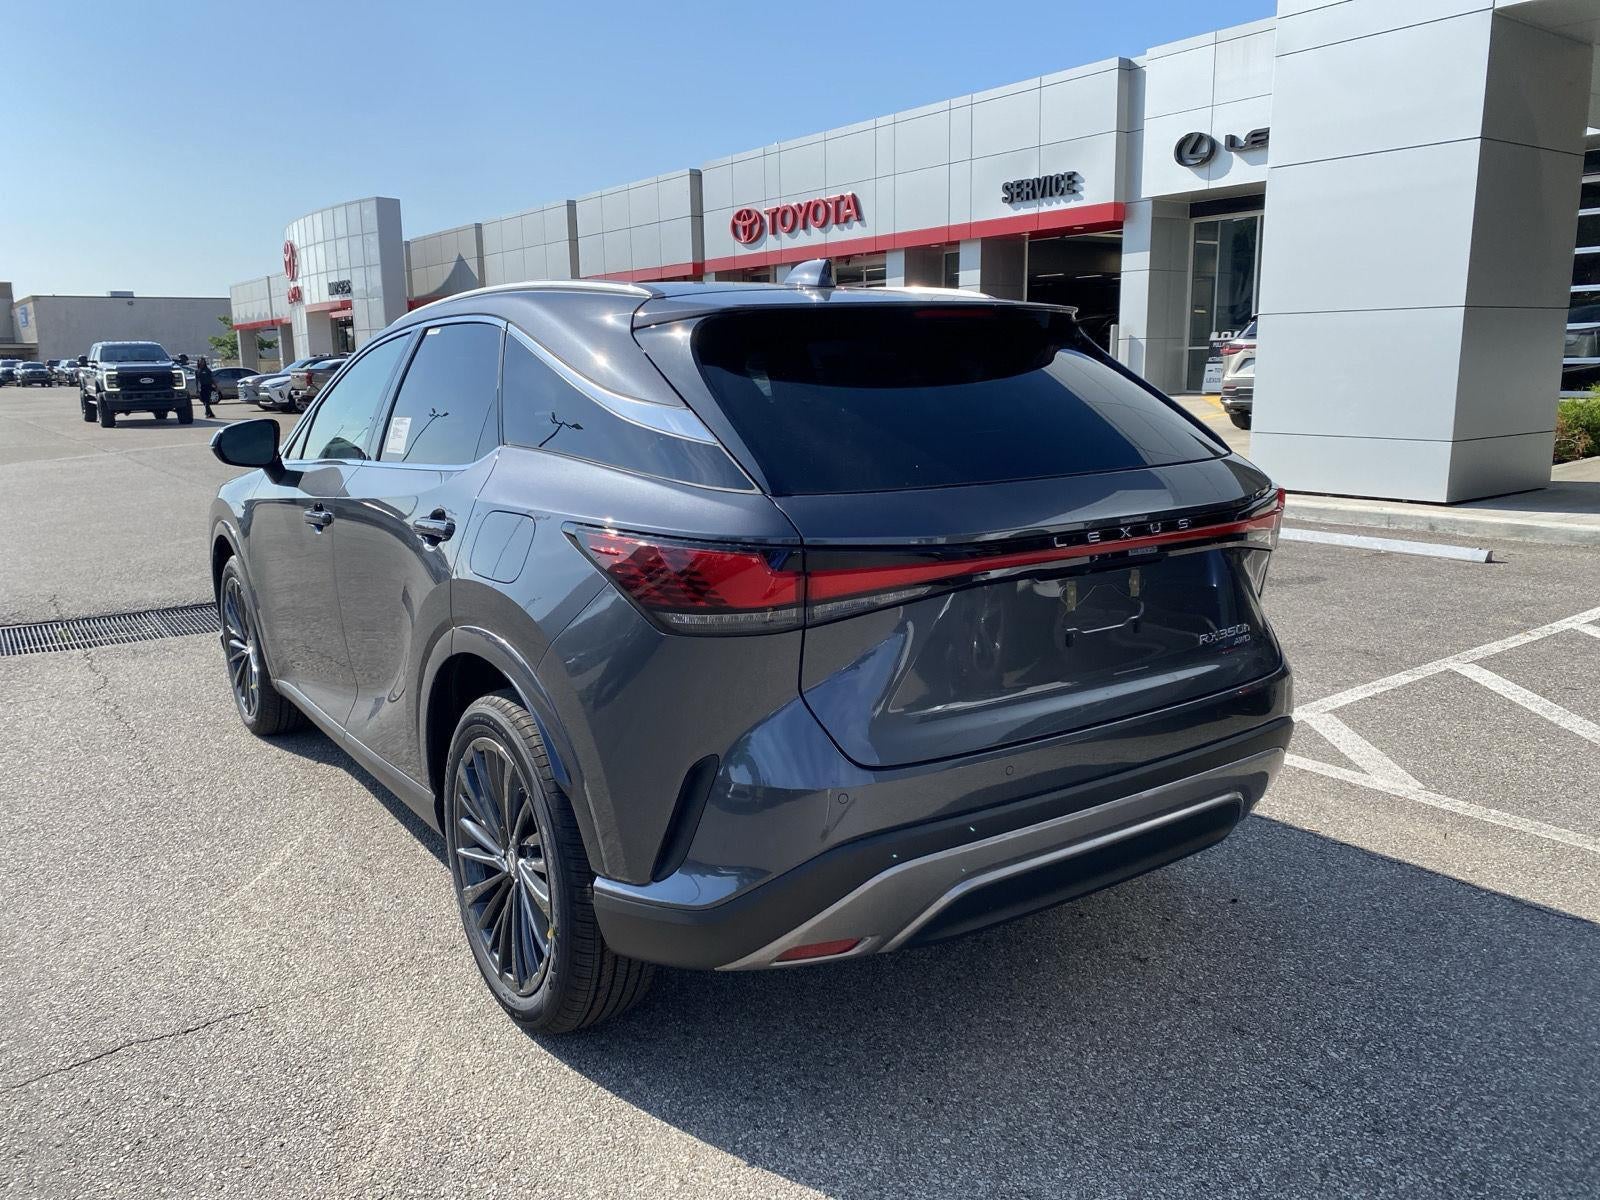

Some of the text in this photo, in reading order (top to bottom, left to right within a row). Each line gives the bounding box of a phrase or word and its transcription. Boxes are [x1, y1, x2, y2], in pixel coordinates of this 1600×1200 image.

[1225, 127, 1270, 152] LE
[1002, 171, 1078, 204] SERVICE
[764, 192, 861, 235] TOYOTA
[1053, 518, 1191, 548] LEXUS
[1233, 634, 1251, 646] AWD
